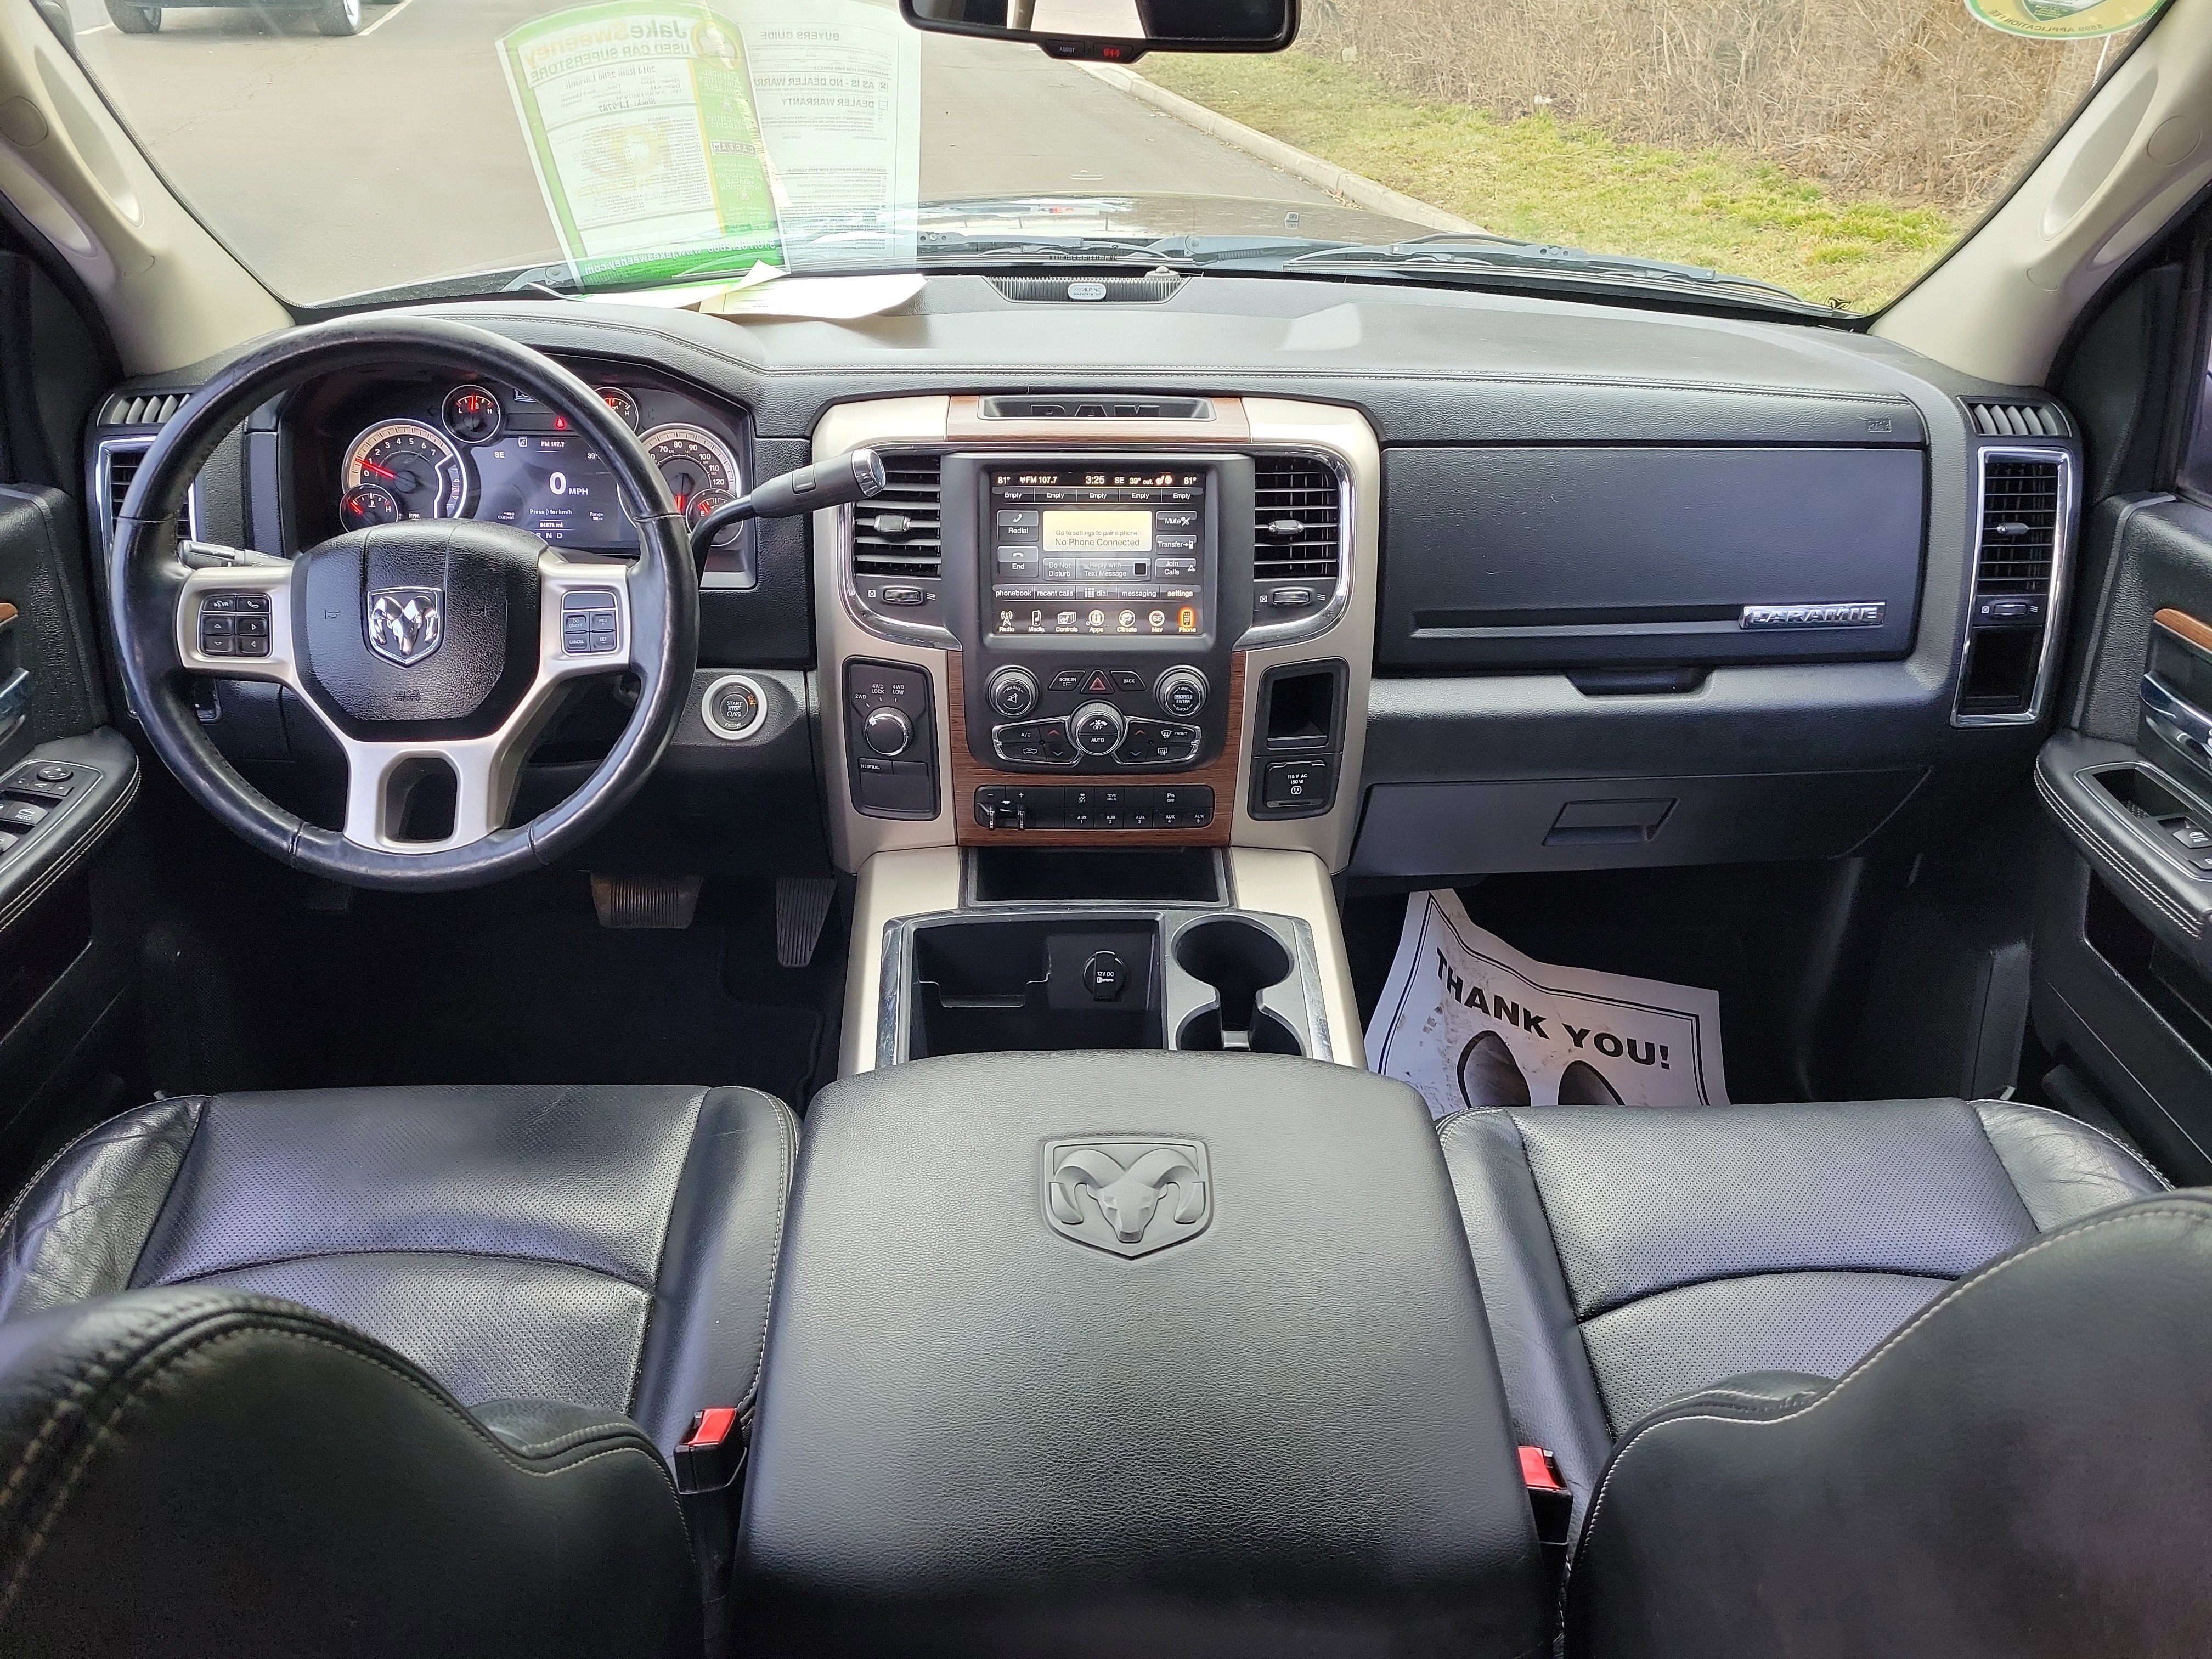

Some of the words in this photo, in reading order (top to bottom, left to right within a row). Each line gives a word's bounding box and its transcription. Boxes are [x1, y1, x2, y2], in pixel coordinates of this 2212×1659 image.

[549, 472, 566, 495] 0
[1085, 476, 1105, 484] 3:25
[1069, 538, 1094, 546] Phone
[1096, 538, 1140, 546] Connected
[1090, 561, 1105, 569] Reply
[1099, 570, 1127, 578] Message
[995, 589, 1032, 597] phonebook
[1121, 590, 1156, 598] messaging
[1436, 946, 1551, 1040] THANK
[1561, 1023, 1671, 1071] YOU!
